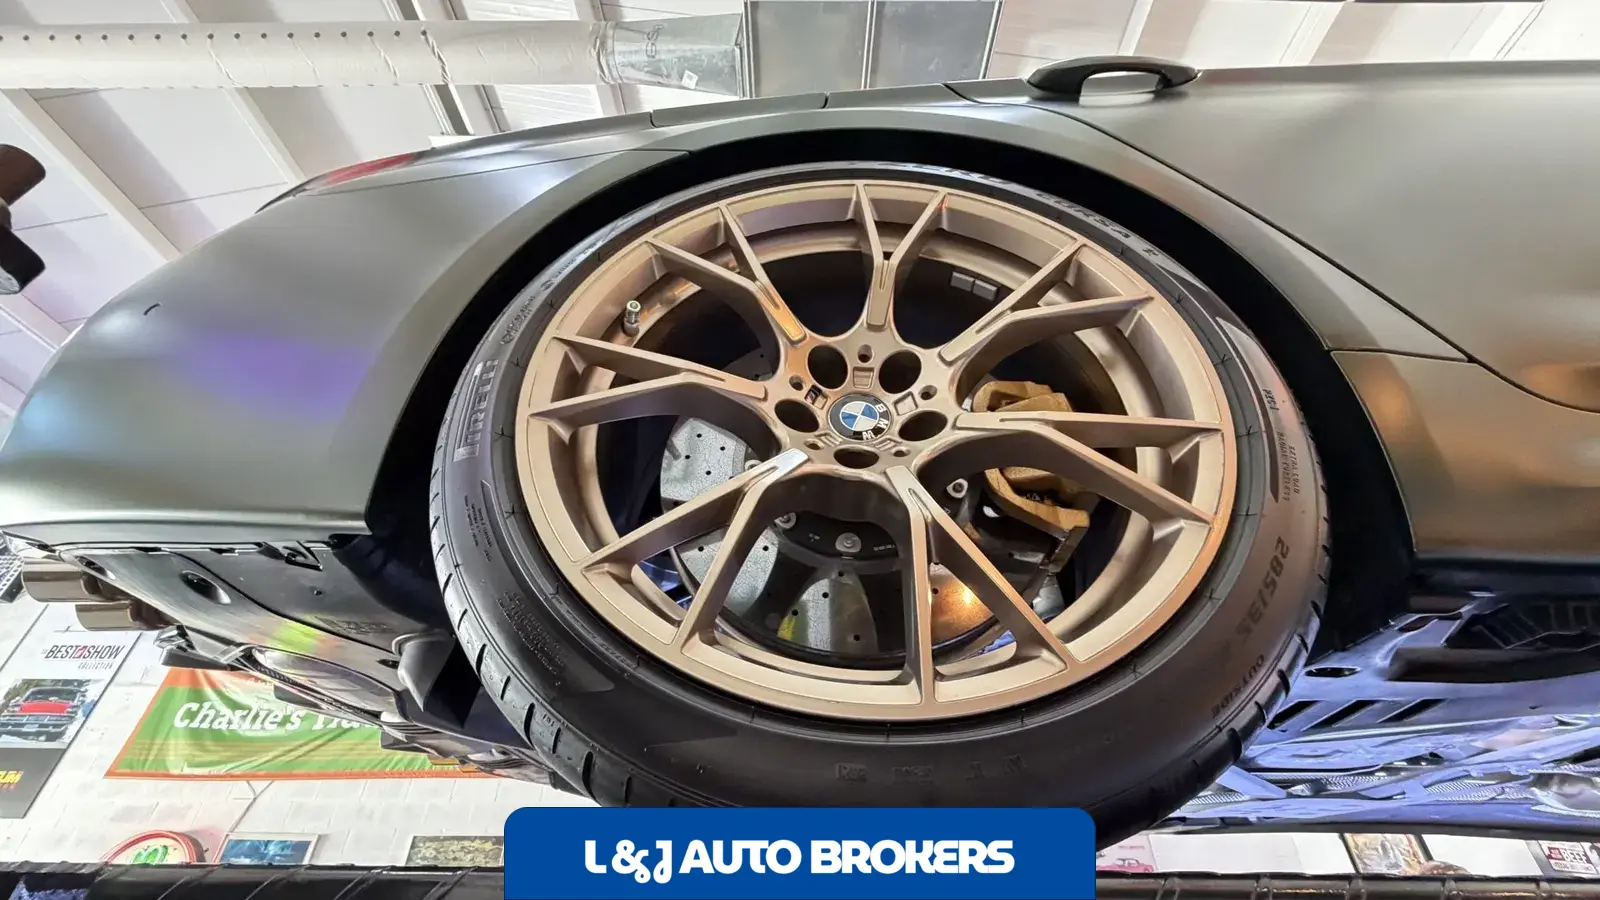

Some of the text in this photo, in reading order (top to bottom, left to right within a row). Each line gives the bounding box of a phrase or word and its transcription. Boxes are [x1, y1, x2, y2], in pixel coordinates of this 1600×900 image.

[453, 359, 499, 462] PIRELLI
[861, 403, 889, 441] BMW
[44, 645, 79, 659] BEST
[82, 645, 125, 659] SHOW
[1211, 654, 1265, 718] OUTSIDE
[173, 701, 307, 731] Charlie's
